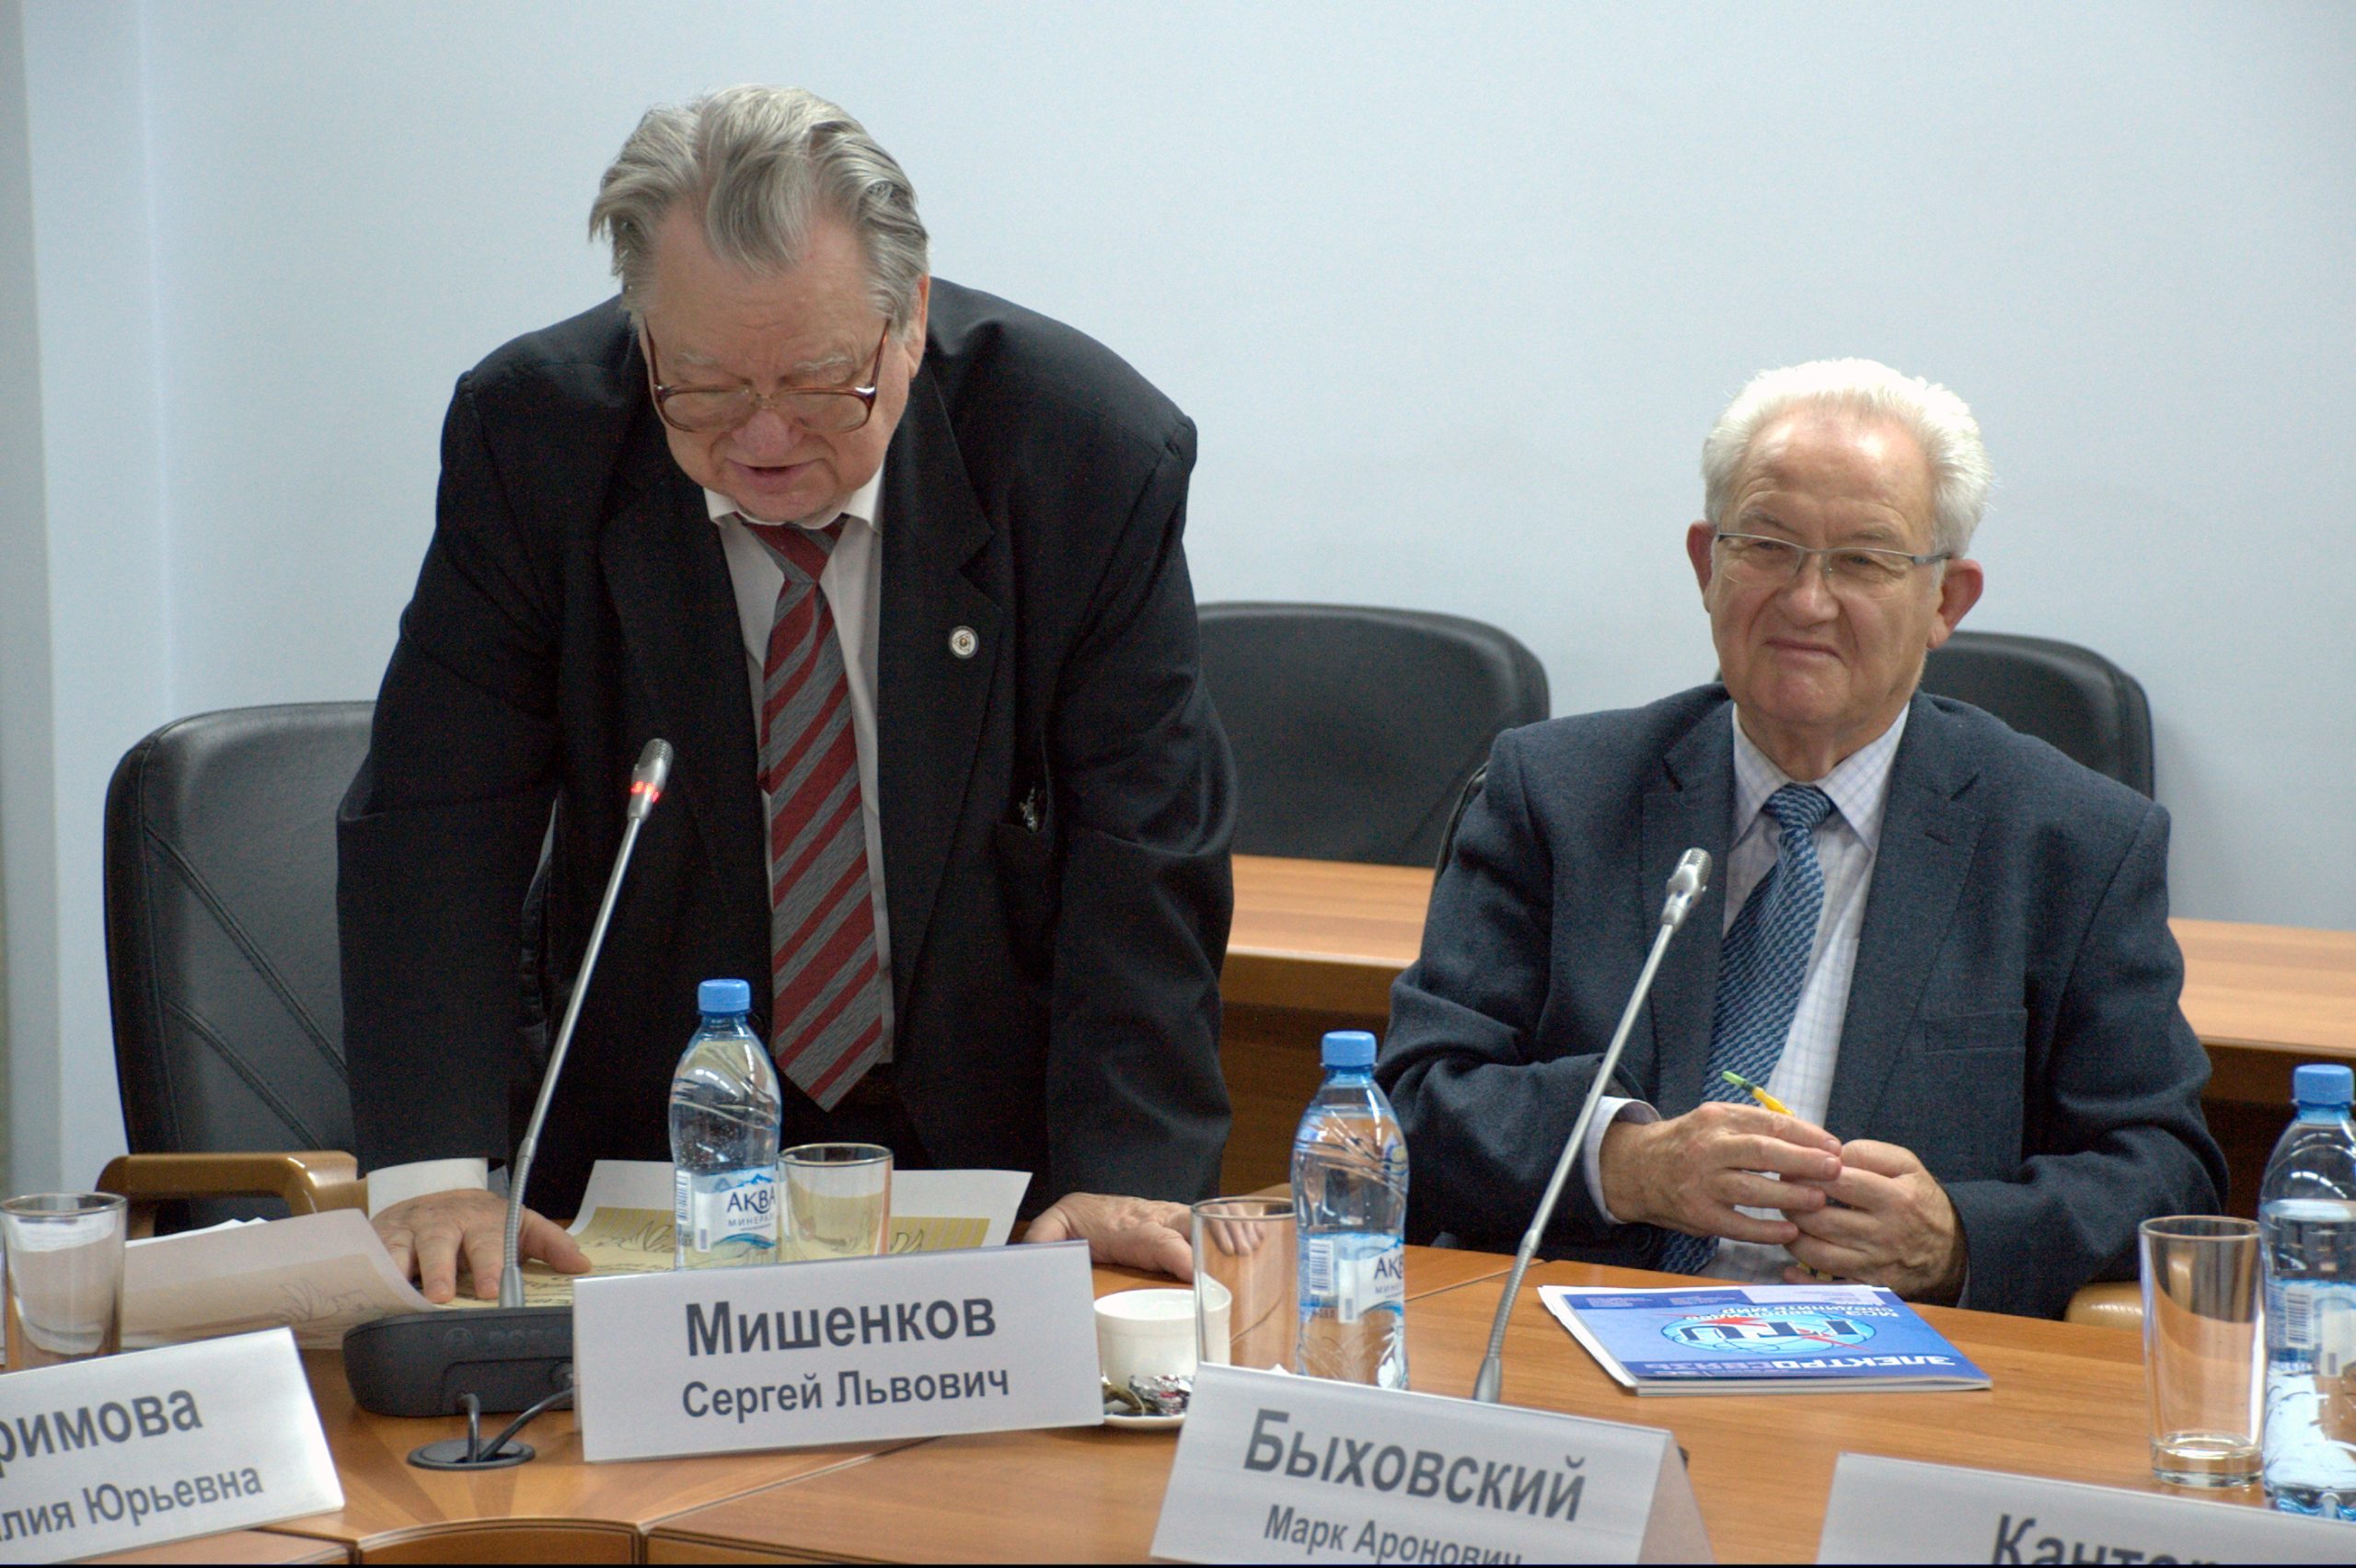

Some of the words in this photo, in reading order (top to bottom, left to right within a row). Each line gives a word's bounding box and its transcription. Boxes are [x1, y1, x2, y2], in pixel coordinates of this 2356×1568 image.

[686, 1297, 997, 1356] Мишенков
[1678, 1320, 1860, 1341] ITU
[683, 1372, 823, 1424] Сергей
[836, 1369, 1010, 1407] Львович
[1243, 1408, 1586, 1522] Быховский
[82, 1467, 264, 1527] Юрьевна
[1264, 1504, 1349, 1555] Марк
